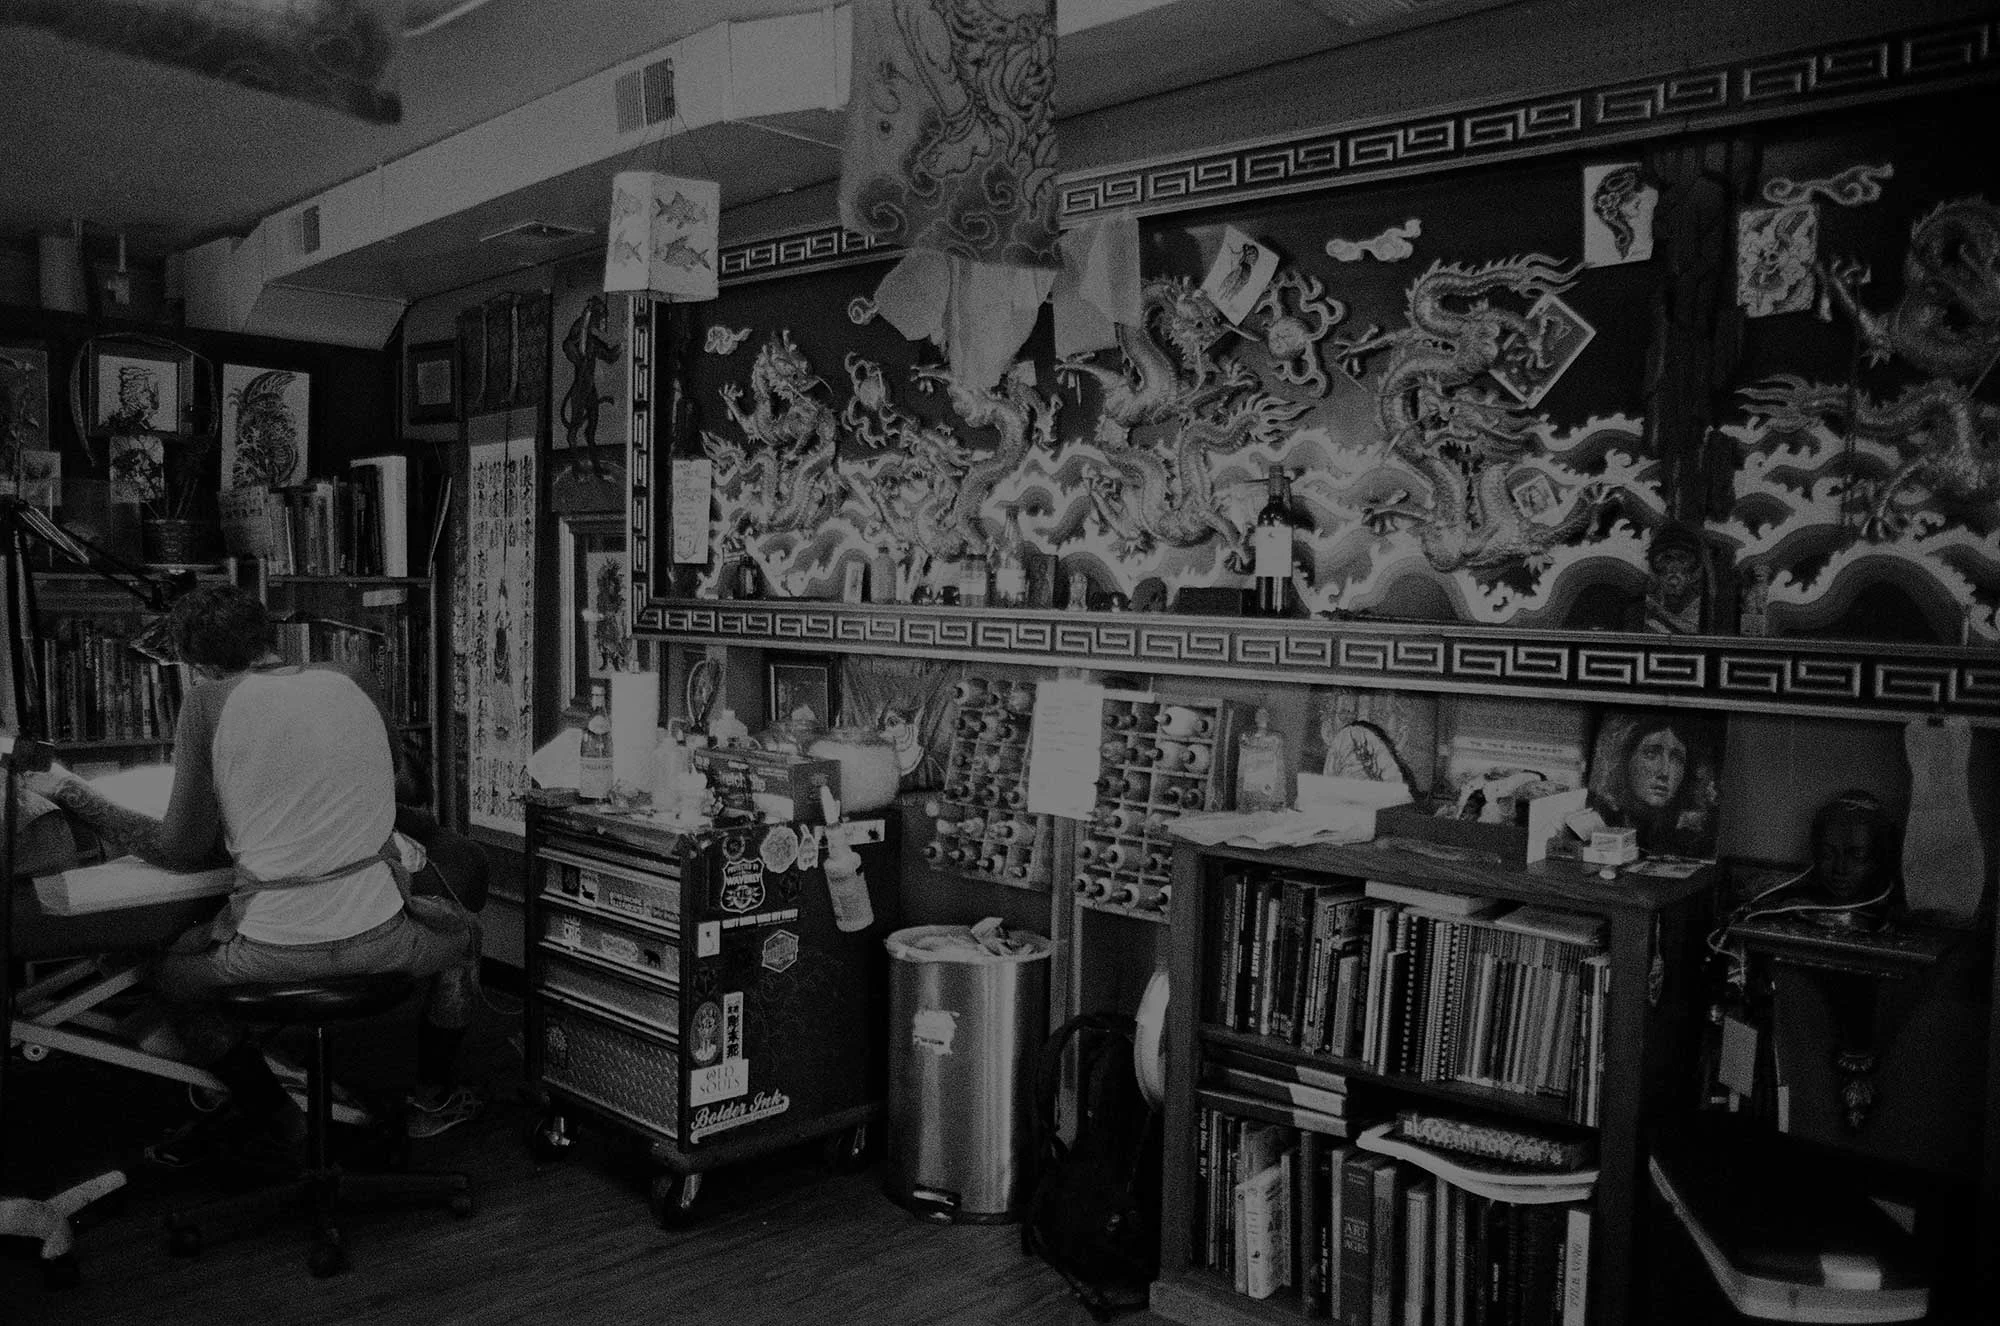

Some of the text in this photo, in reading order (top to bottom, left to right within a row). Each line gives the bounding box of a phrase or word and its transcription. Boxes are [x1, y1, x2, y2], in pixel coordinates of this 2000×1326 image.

[706, 1065, 734, 1081] OLD
[699, 1078, 741, 1095] SOULS
[691, 1099, 746, 1130] Bolder
[750, 1088, 783, 1112] Ink
[1344, 1222, 1368, 1240] ART
